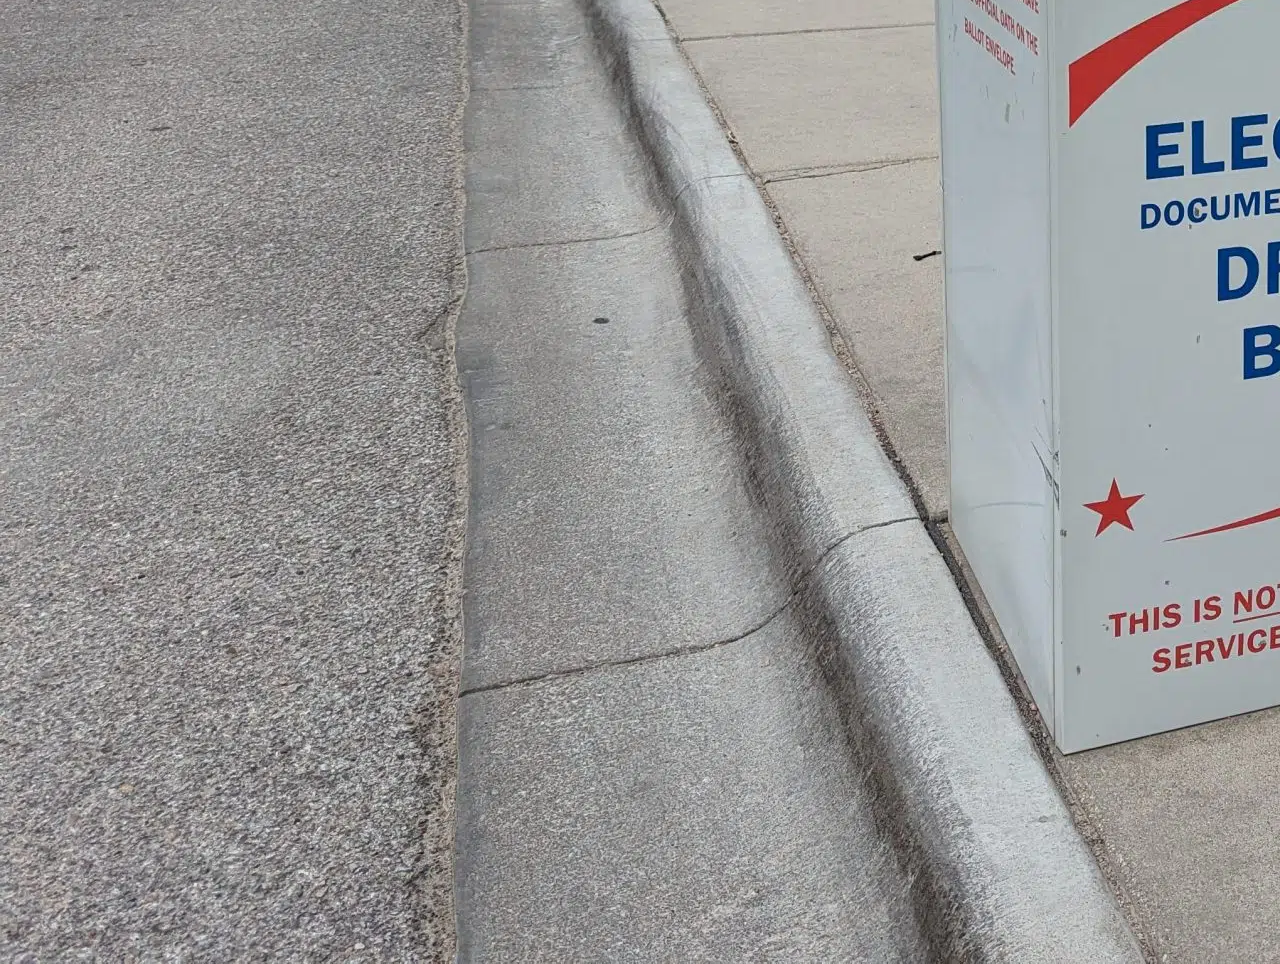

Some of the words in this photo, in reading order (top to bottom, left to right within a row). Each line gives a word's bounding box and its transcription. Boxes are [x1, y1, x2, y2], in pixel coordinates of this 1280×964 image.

[964, 17, 985, 48] BALLOT
[1000, 9, 1015, 37] OATH
[1016, 22, 1025, 45] ON
[1025, 29, 1039, 56] THE
[1108, 603, 1181, 638] THIS
[1193, 595, 1222, 624] IS
